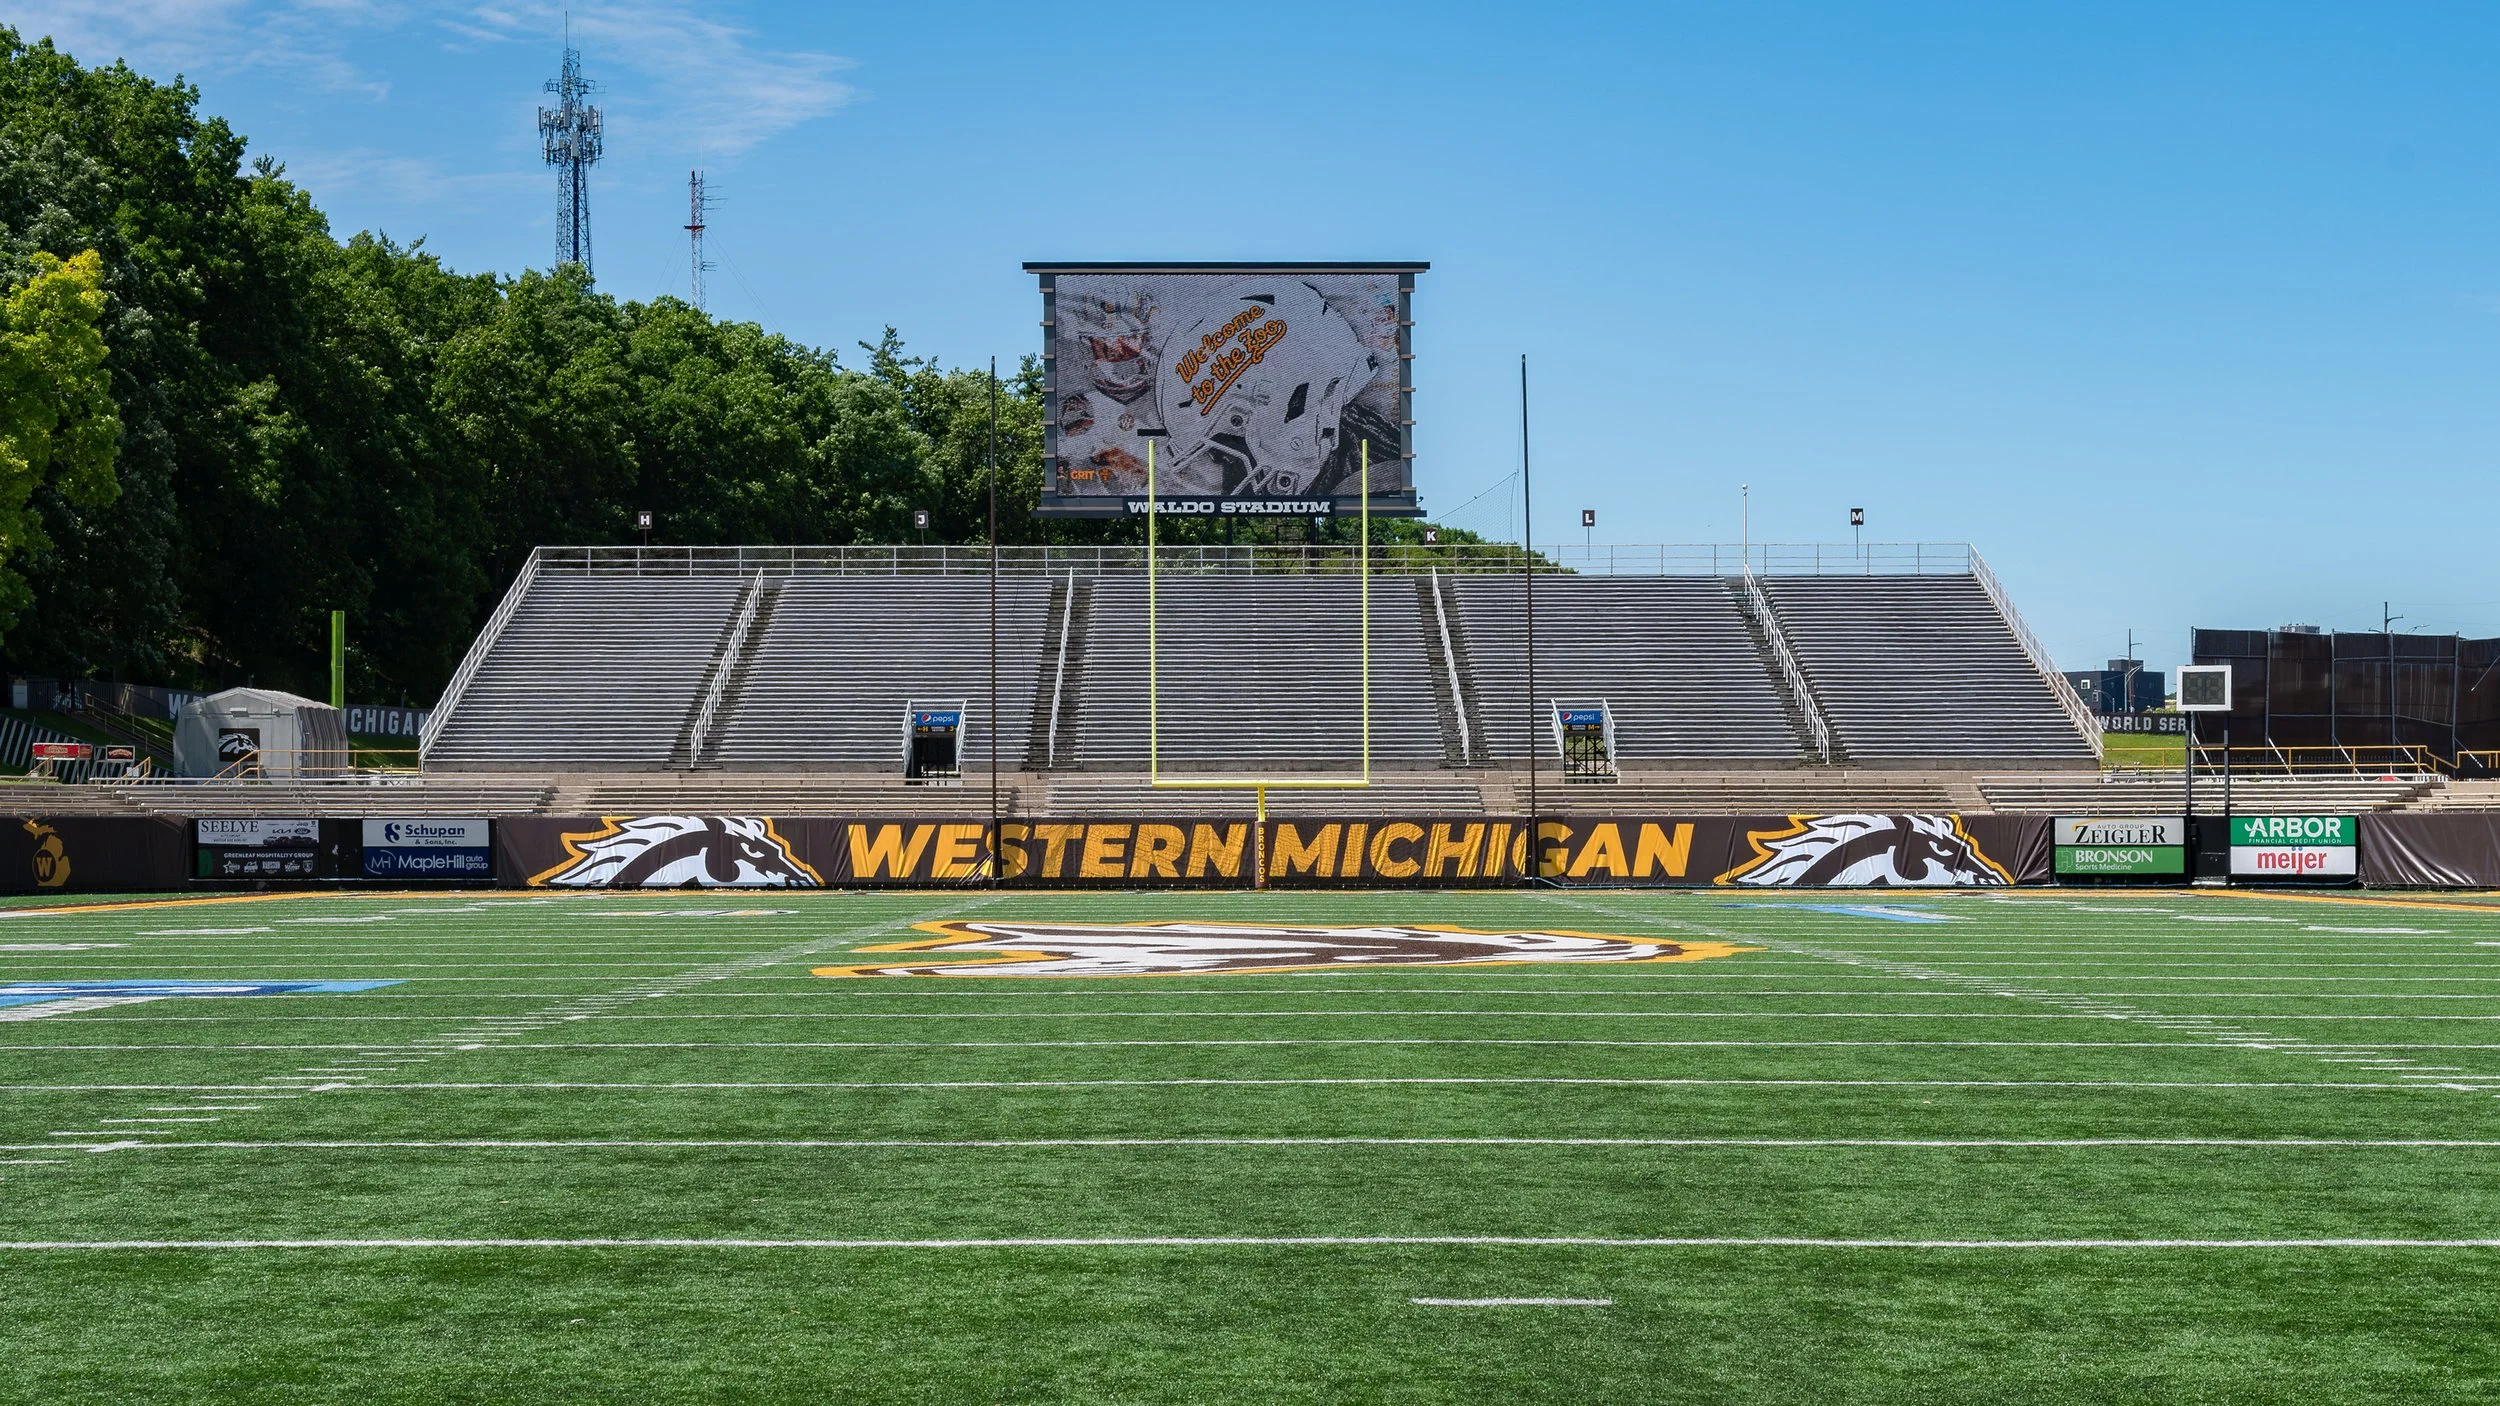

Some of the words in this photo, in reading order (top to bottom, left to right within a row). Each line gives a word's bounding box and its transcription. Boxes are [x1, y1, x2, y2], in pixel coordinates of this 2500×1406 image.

[1176, 306, 1265, 383] Welcome
[1192, 379, 1214, 403] to
[1211, 348, 1246, 381] the
[1238, 320, 1287, 358] Zoo
[1070, 469, 1095, 480] GRIT
[1128, 501, 1215, 513] WALDO
[1220, 501, 1330, 513] STADIUM
[640, 515, 650, 525] H
[917, 514, 925, 525] J
[1585, 513, 1593, 523] L
[1851, 511, 1863, 522] M
[1426, 531, 1436, 541] K
[932, 715, 954, 723] pepsi
[1573, 713, 1595, 721] pepsi
[2095, 715, 2152, 731] WORLD
[2159, 717, 2187, 731] SER
[200, 820, 259, 833] SEELYE
[405, 824, 465, 838] Schupan
[2244, 817, 2341, 838] ARBOR
[2074, 824, 2167, 843] ZEIGLER
[847, 823, 1248, 878] WESTERN
[1268, 823, 1695, 877] MICHIGAN
[2075, 849, 2153, 863] BRONSON
[36, 856, 53, 877] W
[465, 862, 489, 870] group
[2257, 846, 2328, 874] meijer
